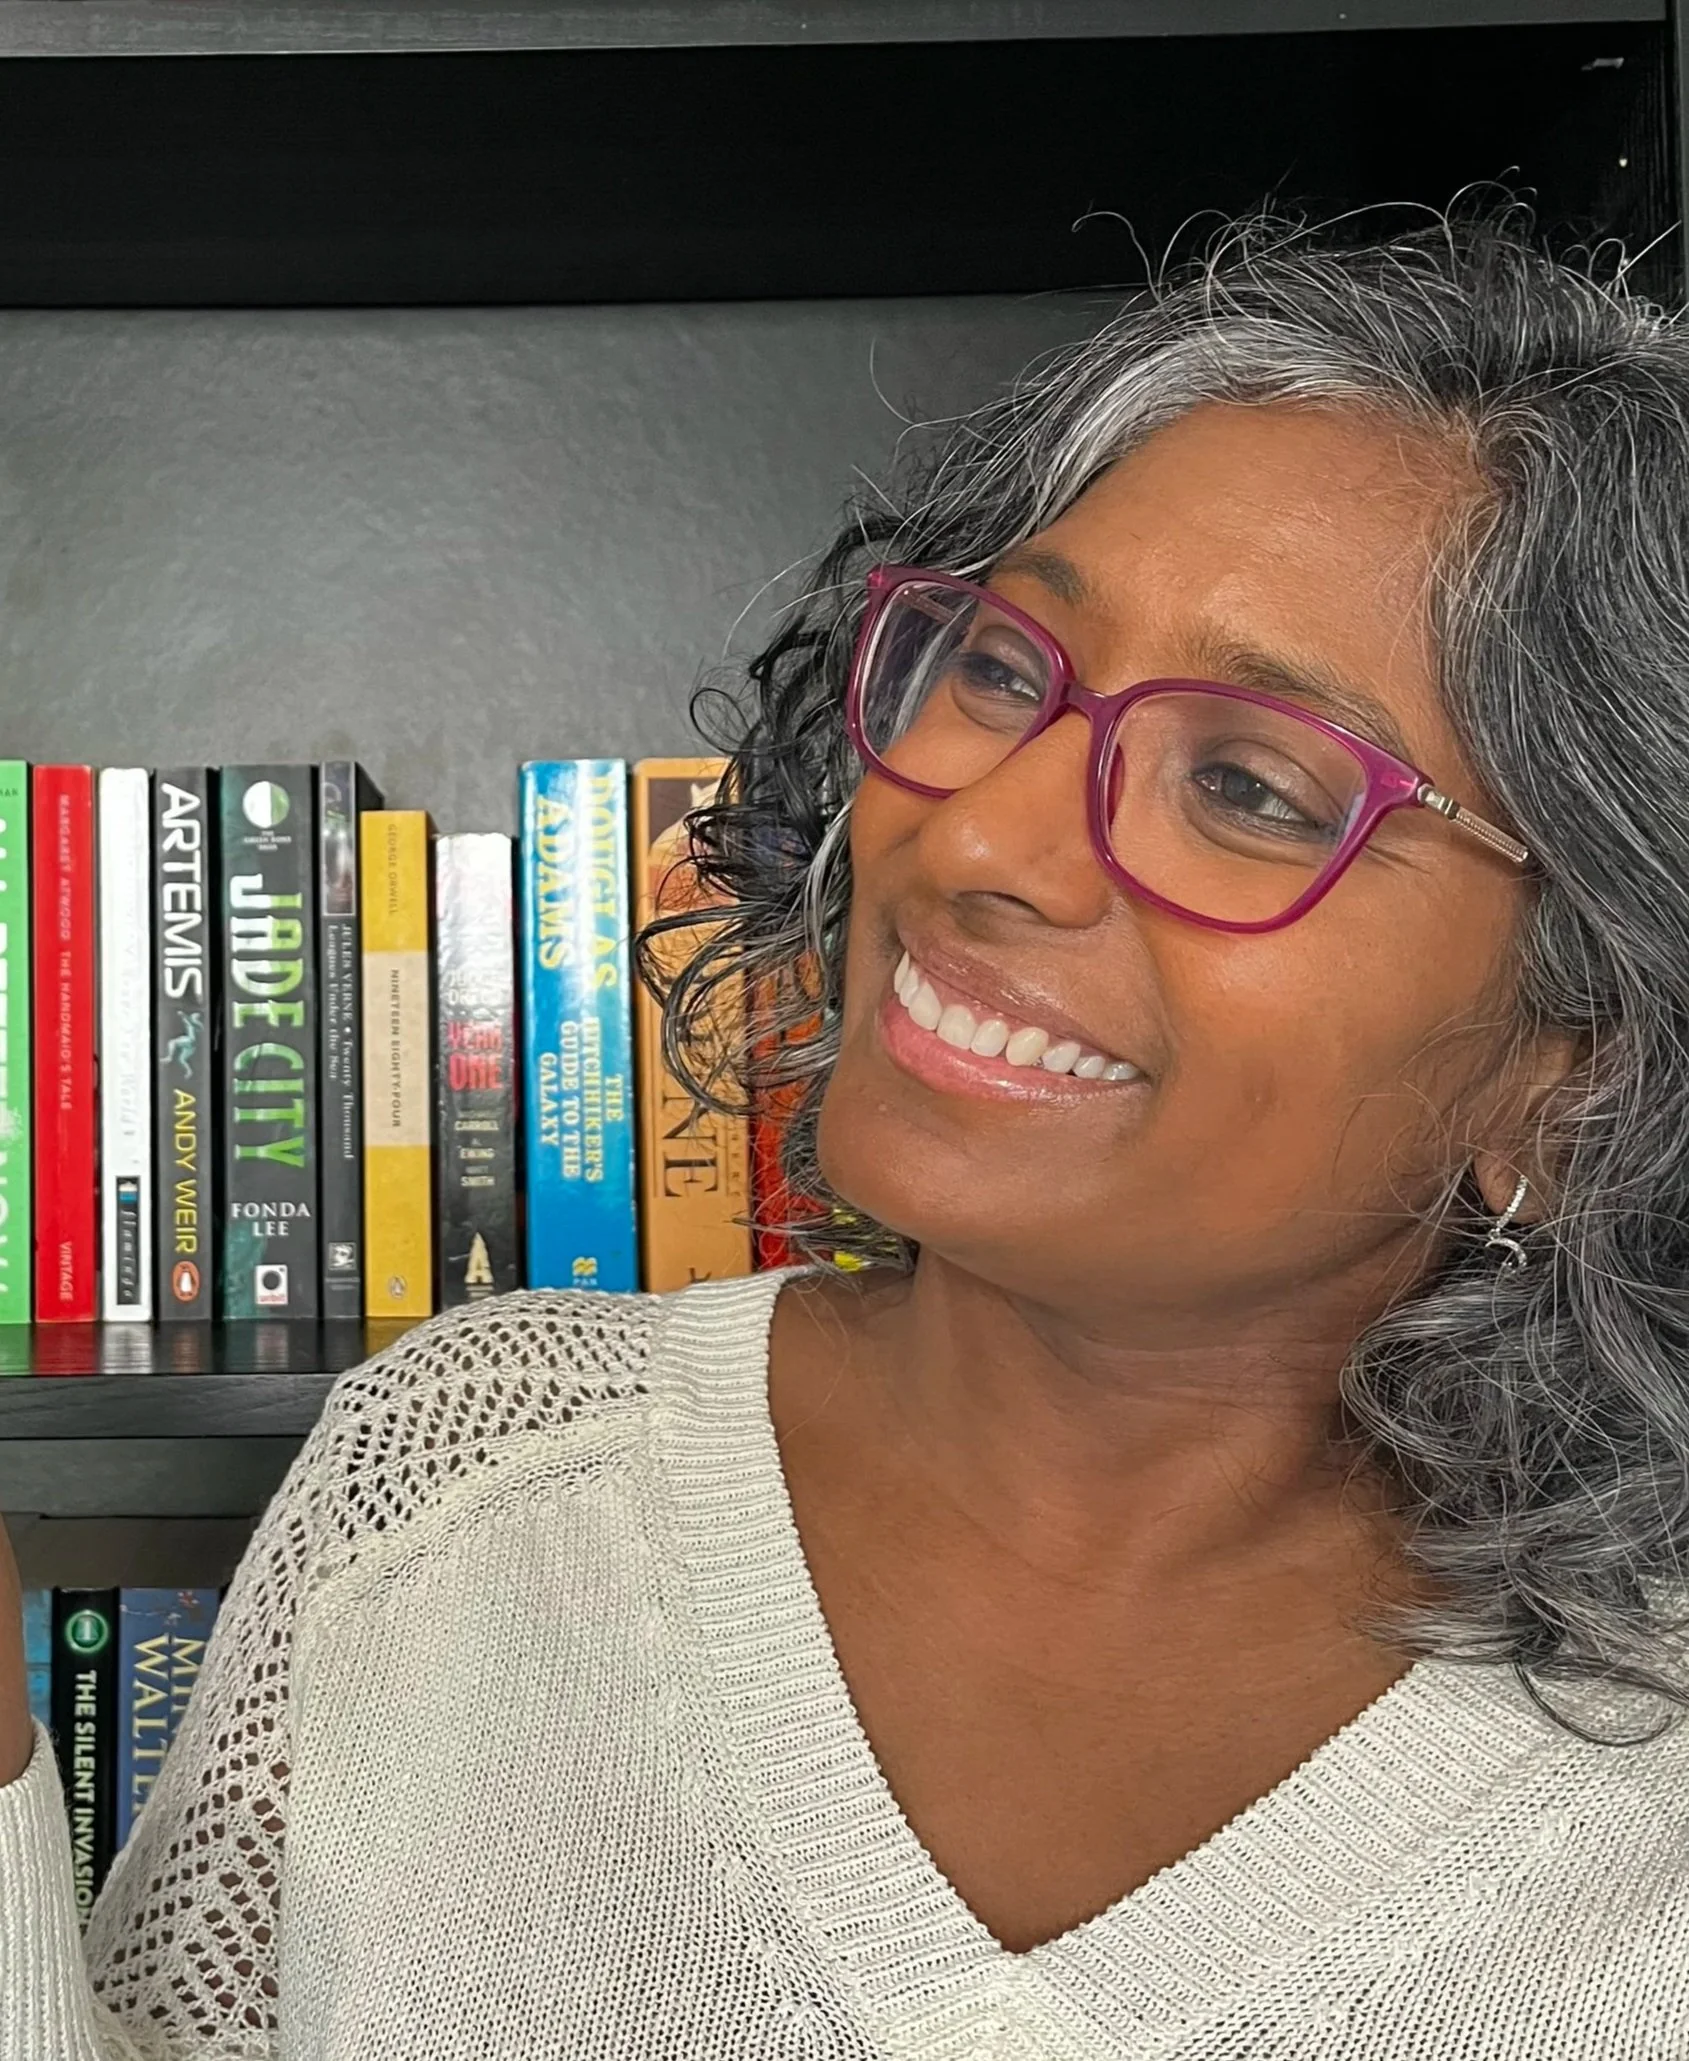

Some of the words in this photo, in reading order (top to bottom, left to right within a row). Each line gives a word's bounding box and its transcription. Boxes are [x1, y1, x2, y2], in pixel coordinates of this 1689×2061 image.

[59, 795, 72, 873] MARGARET
[387, 824, 399, 868] GEORGE
[59, 878, 72, 940] ATWOOD
[161, 782, 203, 999] ARTEMIS
[388, 872, 399, 916] ORWELL
[537, 794, 578, 970] ADAMS
[60, 951, 72, 977] THE
[229, 873, 304, 1028] JADE
[342, 973, 354, 1021] VERNE
[390, 969, 401, 1036] NINETEEN
[449, 1054, 503, 1091] ONE
[560, 1020, 580, 1090] GUIDE
[60, 1074, 73, 1110] TALE
[233, 1042, 305, 1168] CITY
[539, 1052, 559, 1146] GALAXY
[562, 1096, 580, 1125] TO
[605, 1074, 623, 1121] THE
[173, 1089, 197, 1171] ANDY
[562, 1130, 581, 1178] THE
[174, 1179, 198, 1254] WEIR
[231, 1202, 311, 1218] FONDA
[252, 1221, 290, 1237] LEE
[58, 1240, 73, 1302] VINTAGE
[75, 1671, 96, 1717] THE
[74, 1722, 96, 1803] SILENT
